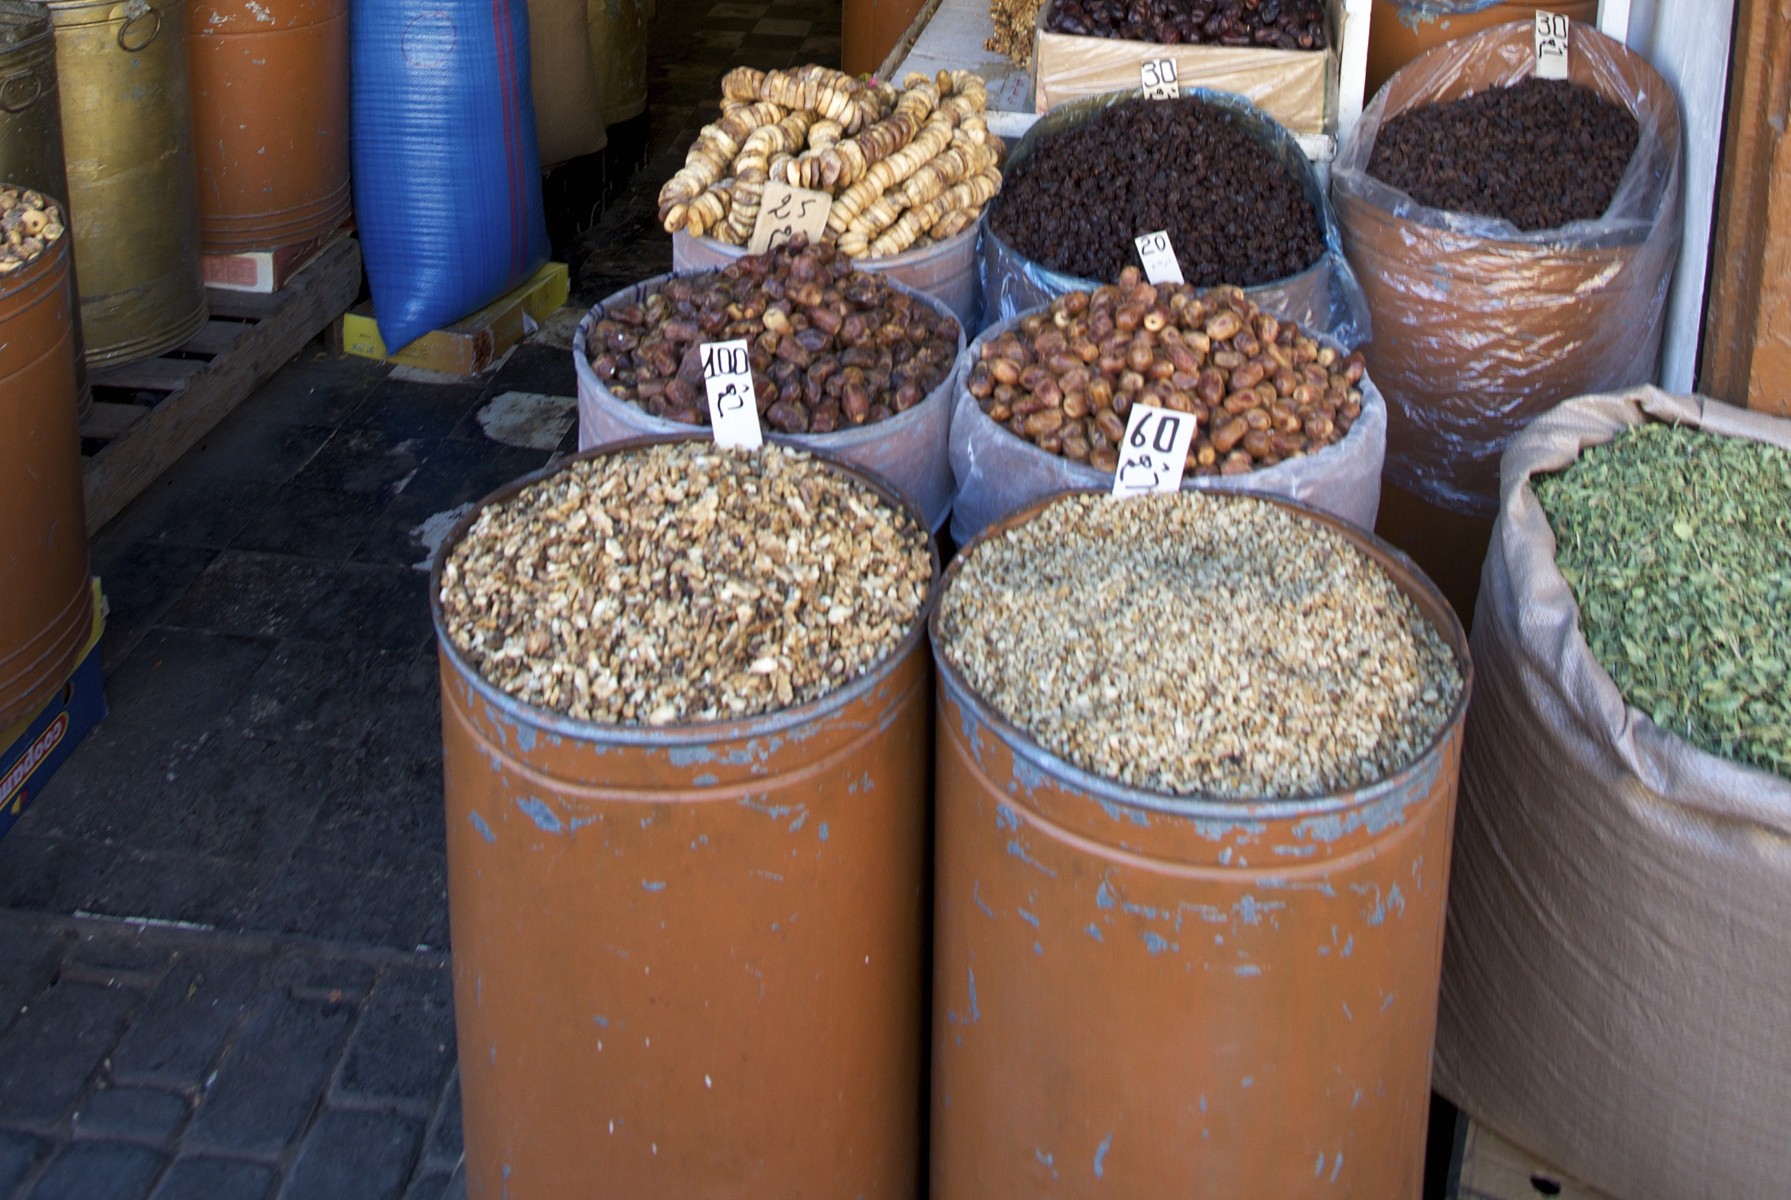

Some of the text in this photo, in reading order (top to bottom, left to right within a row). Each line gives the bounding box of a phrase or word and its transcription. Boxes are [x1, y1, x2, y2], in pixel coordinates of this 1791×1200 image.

[1537, 13, 1567, 39] 30
[1142, 60, 1177, 88] 30
[768, 193, 816, 220] 25
[1141, 235, 1166, 256] 20
[704, 346, 749, 379] 100
[1130, 411, 1180, 453] 60
